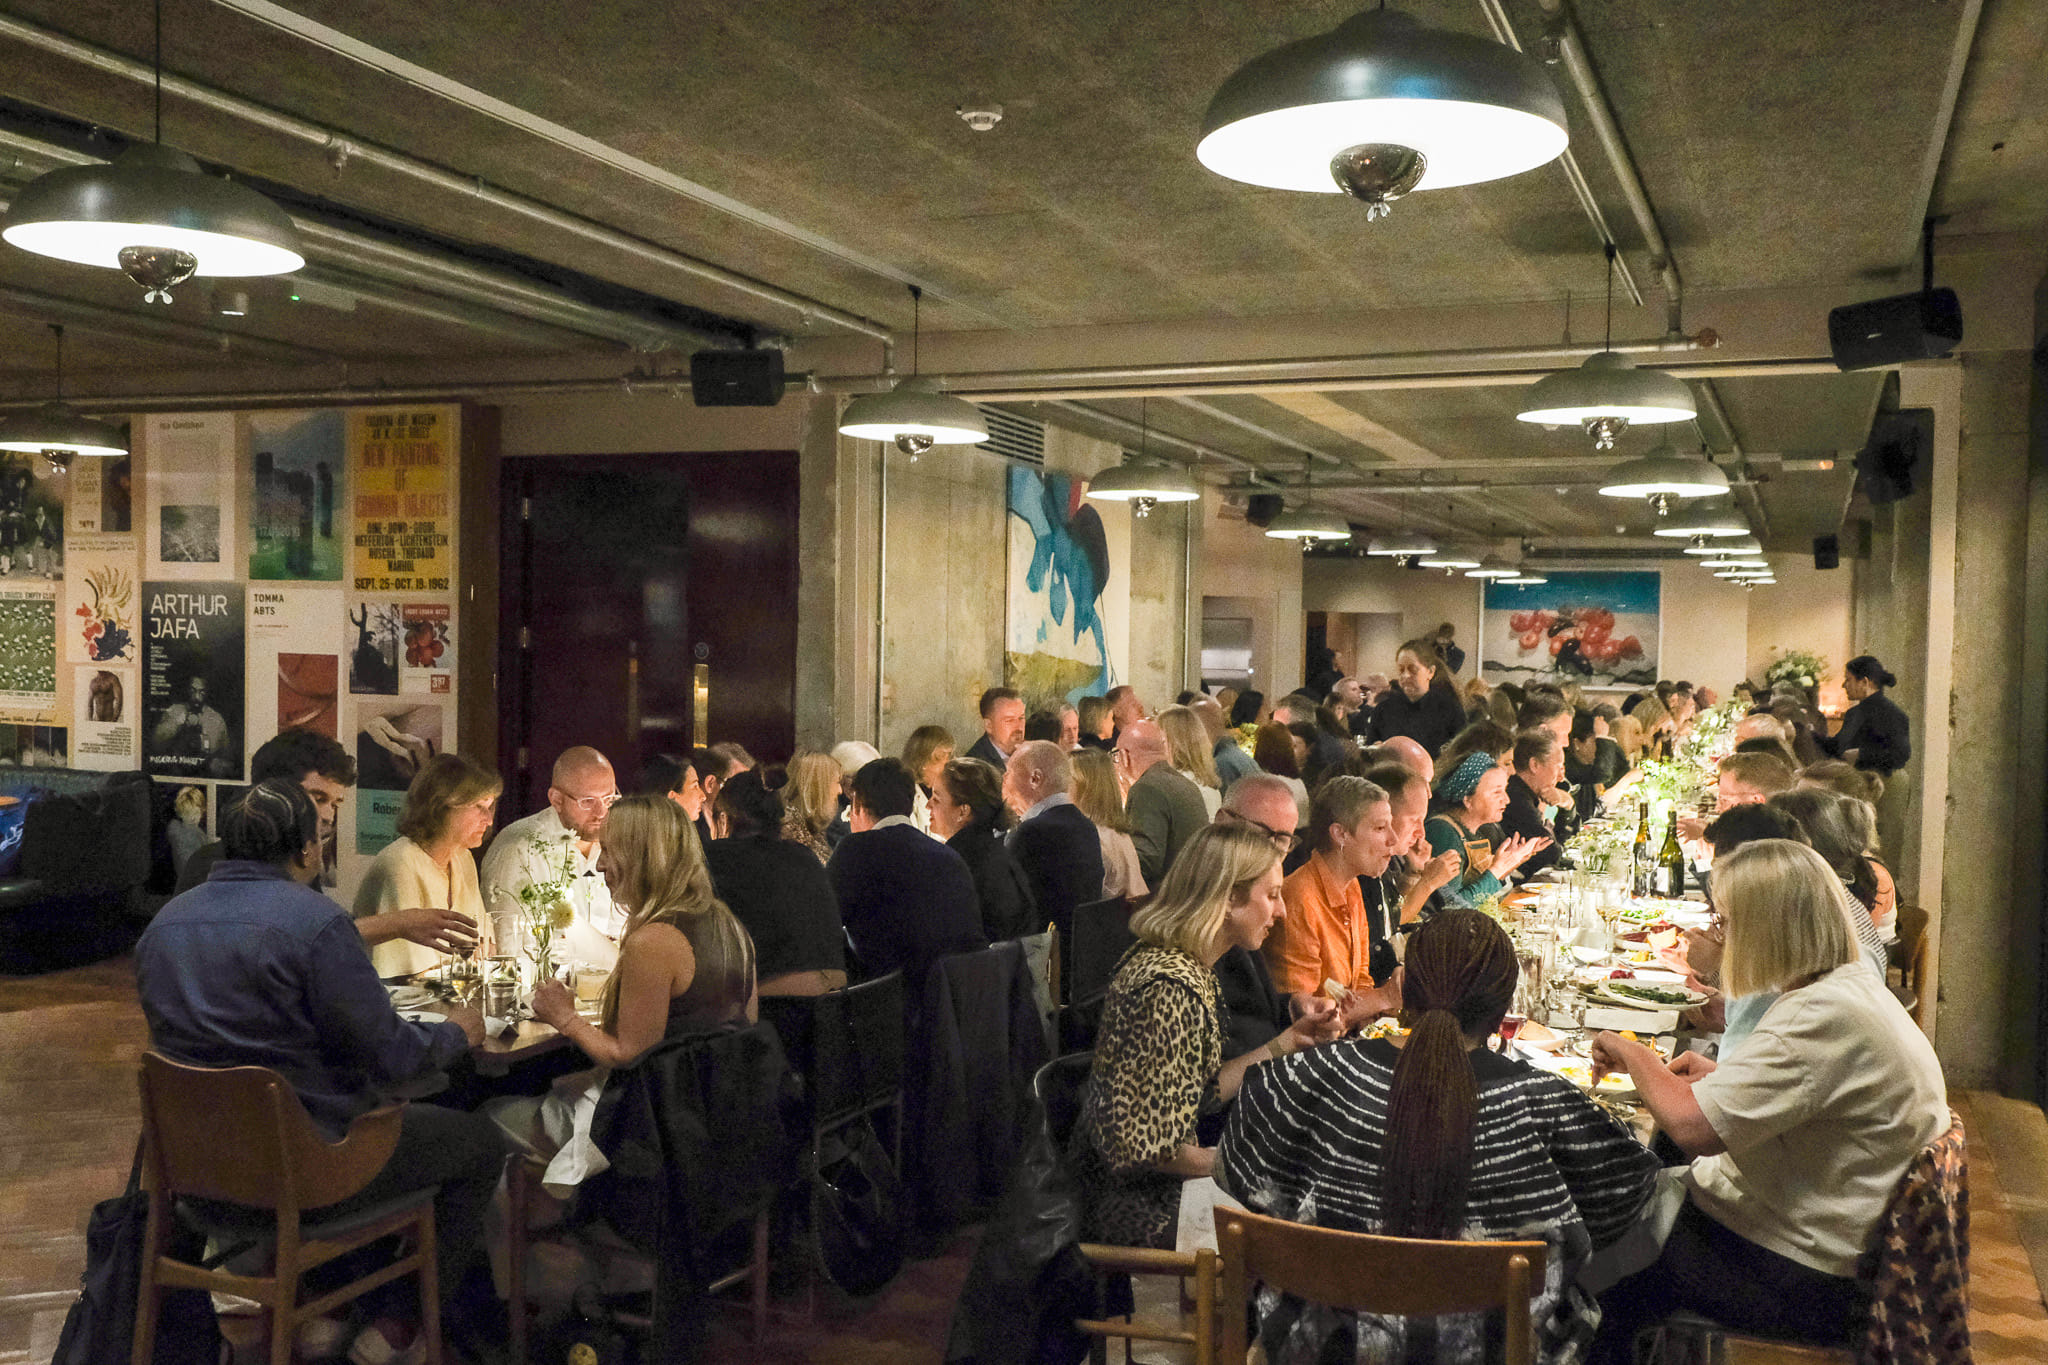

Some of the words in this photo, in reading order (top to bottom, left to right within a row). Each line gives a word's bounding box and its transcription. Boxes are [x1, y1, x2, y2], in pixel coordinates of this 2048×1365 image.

[354, 577, 377, 590] SEPT.
[150, 593, 229, 616] ARTHUR
[254, 593, 285, 603] TOMMA
[253, 606, 276, 616] ABTS
[150, 617, 200, 640] JAFA
[373, 802, 402, 815] Rober
